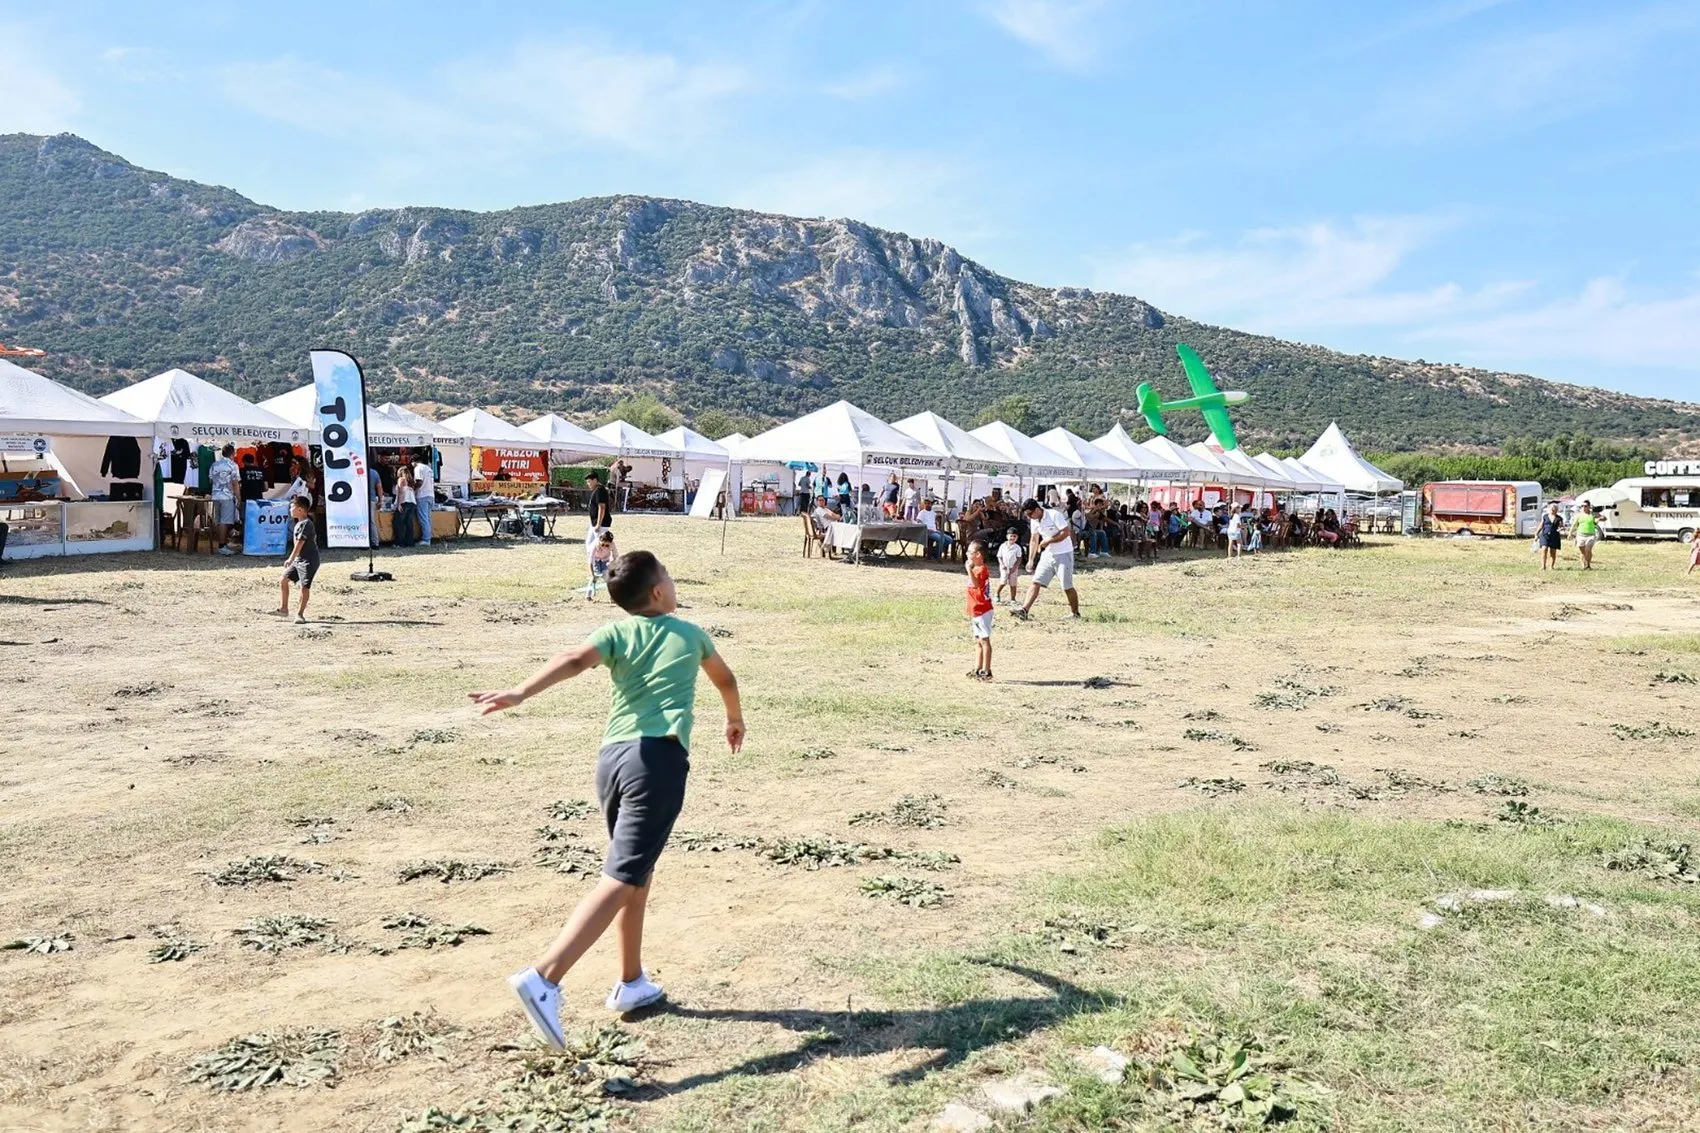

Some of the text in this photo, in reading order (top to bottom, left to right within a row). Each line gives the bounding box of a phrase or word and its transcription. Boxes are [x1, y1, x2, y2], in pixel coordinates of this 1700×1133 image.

[192, 426, 281, 440] SELÇUK BELEDİYESİ
[494, 448, 540, 458] TRABZON
[501, 460, 530, 470] KITIRI
[258, 515, 289, 525] PLOT
